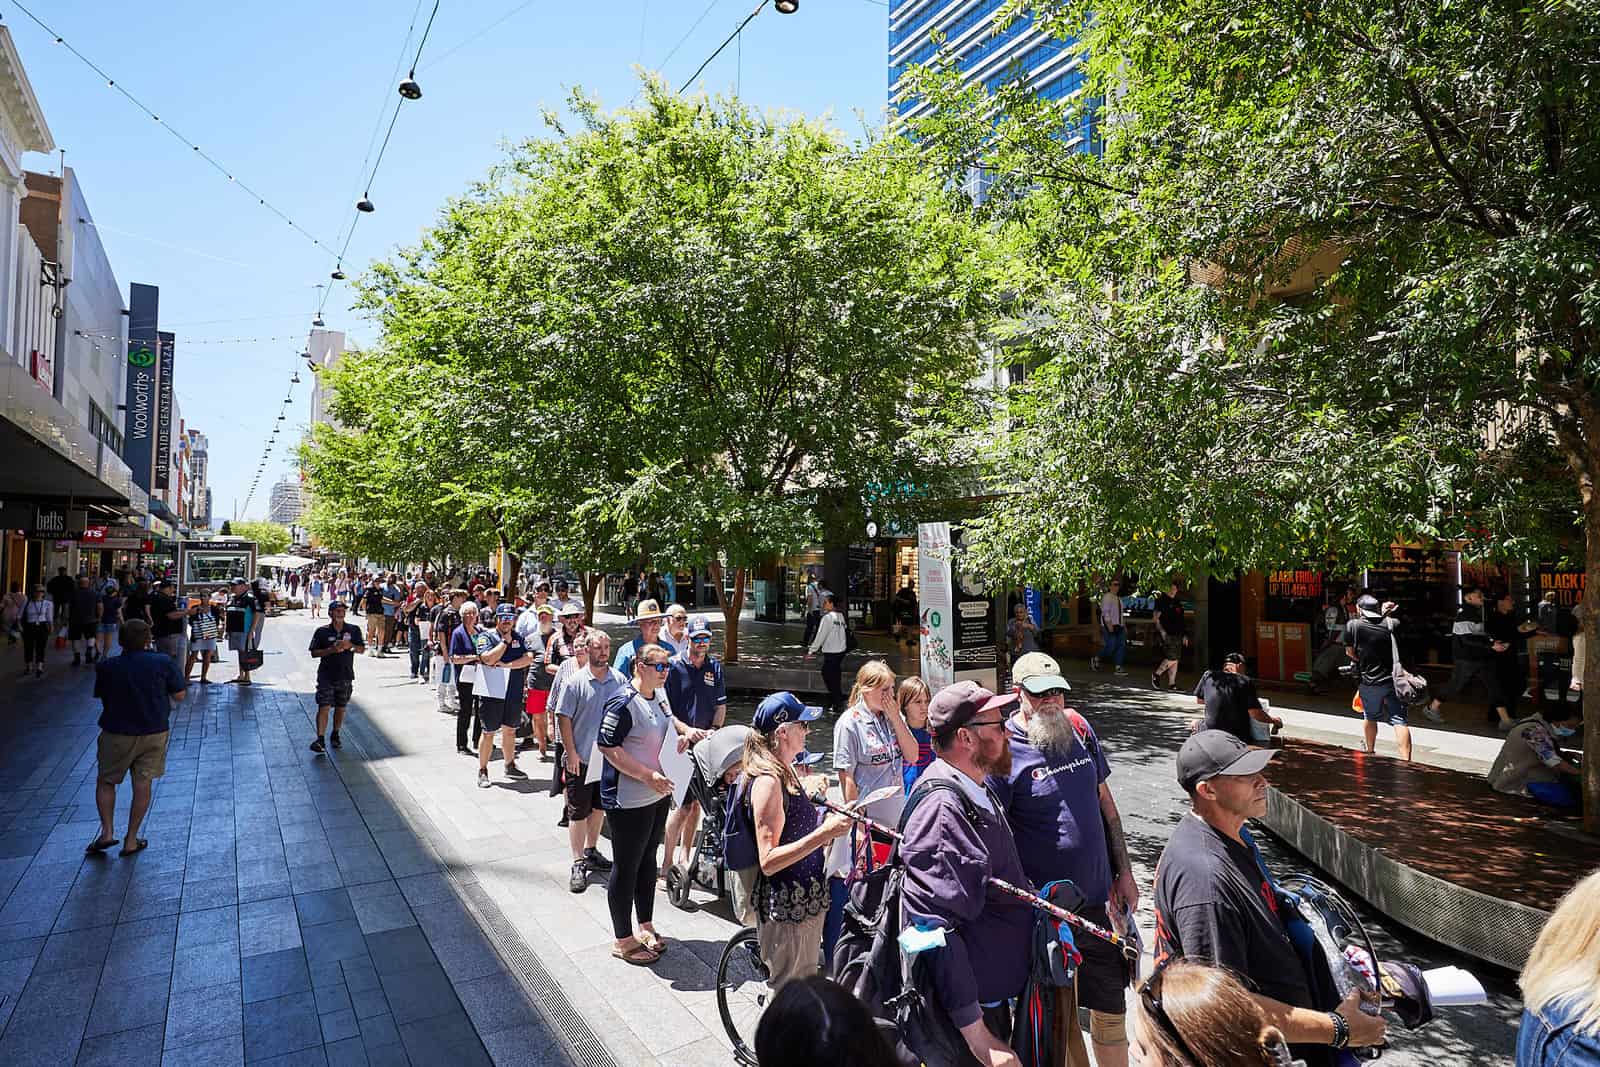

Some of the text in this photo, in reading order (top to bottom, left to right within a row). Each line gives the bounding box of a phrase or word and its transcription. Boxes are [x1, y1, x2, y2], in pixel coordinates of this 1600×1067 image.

[133, 372, 150, 440] Woolworths
[158, 345, 173, 479] ADELAIDE CENTRAL PLAZA
[36, 506, 64, 531] betts
[1269, 570, 1294, 583] BLACK
[1541, 573, 1576, 589] BLACK
[1032, 757, 1092, 781] Champion
